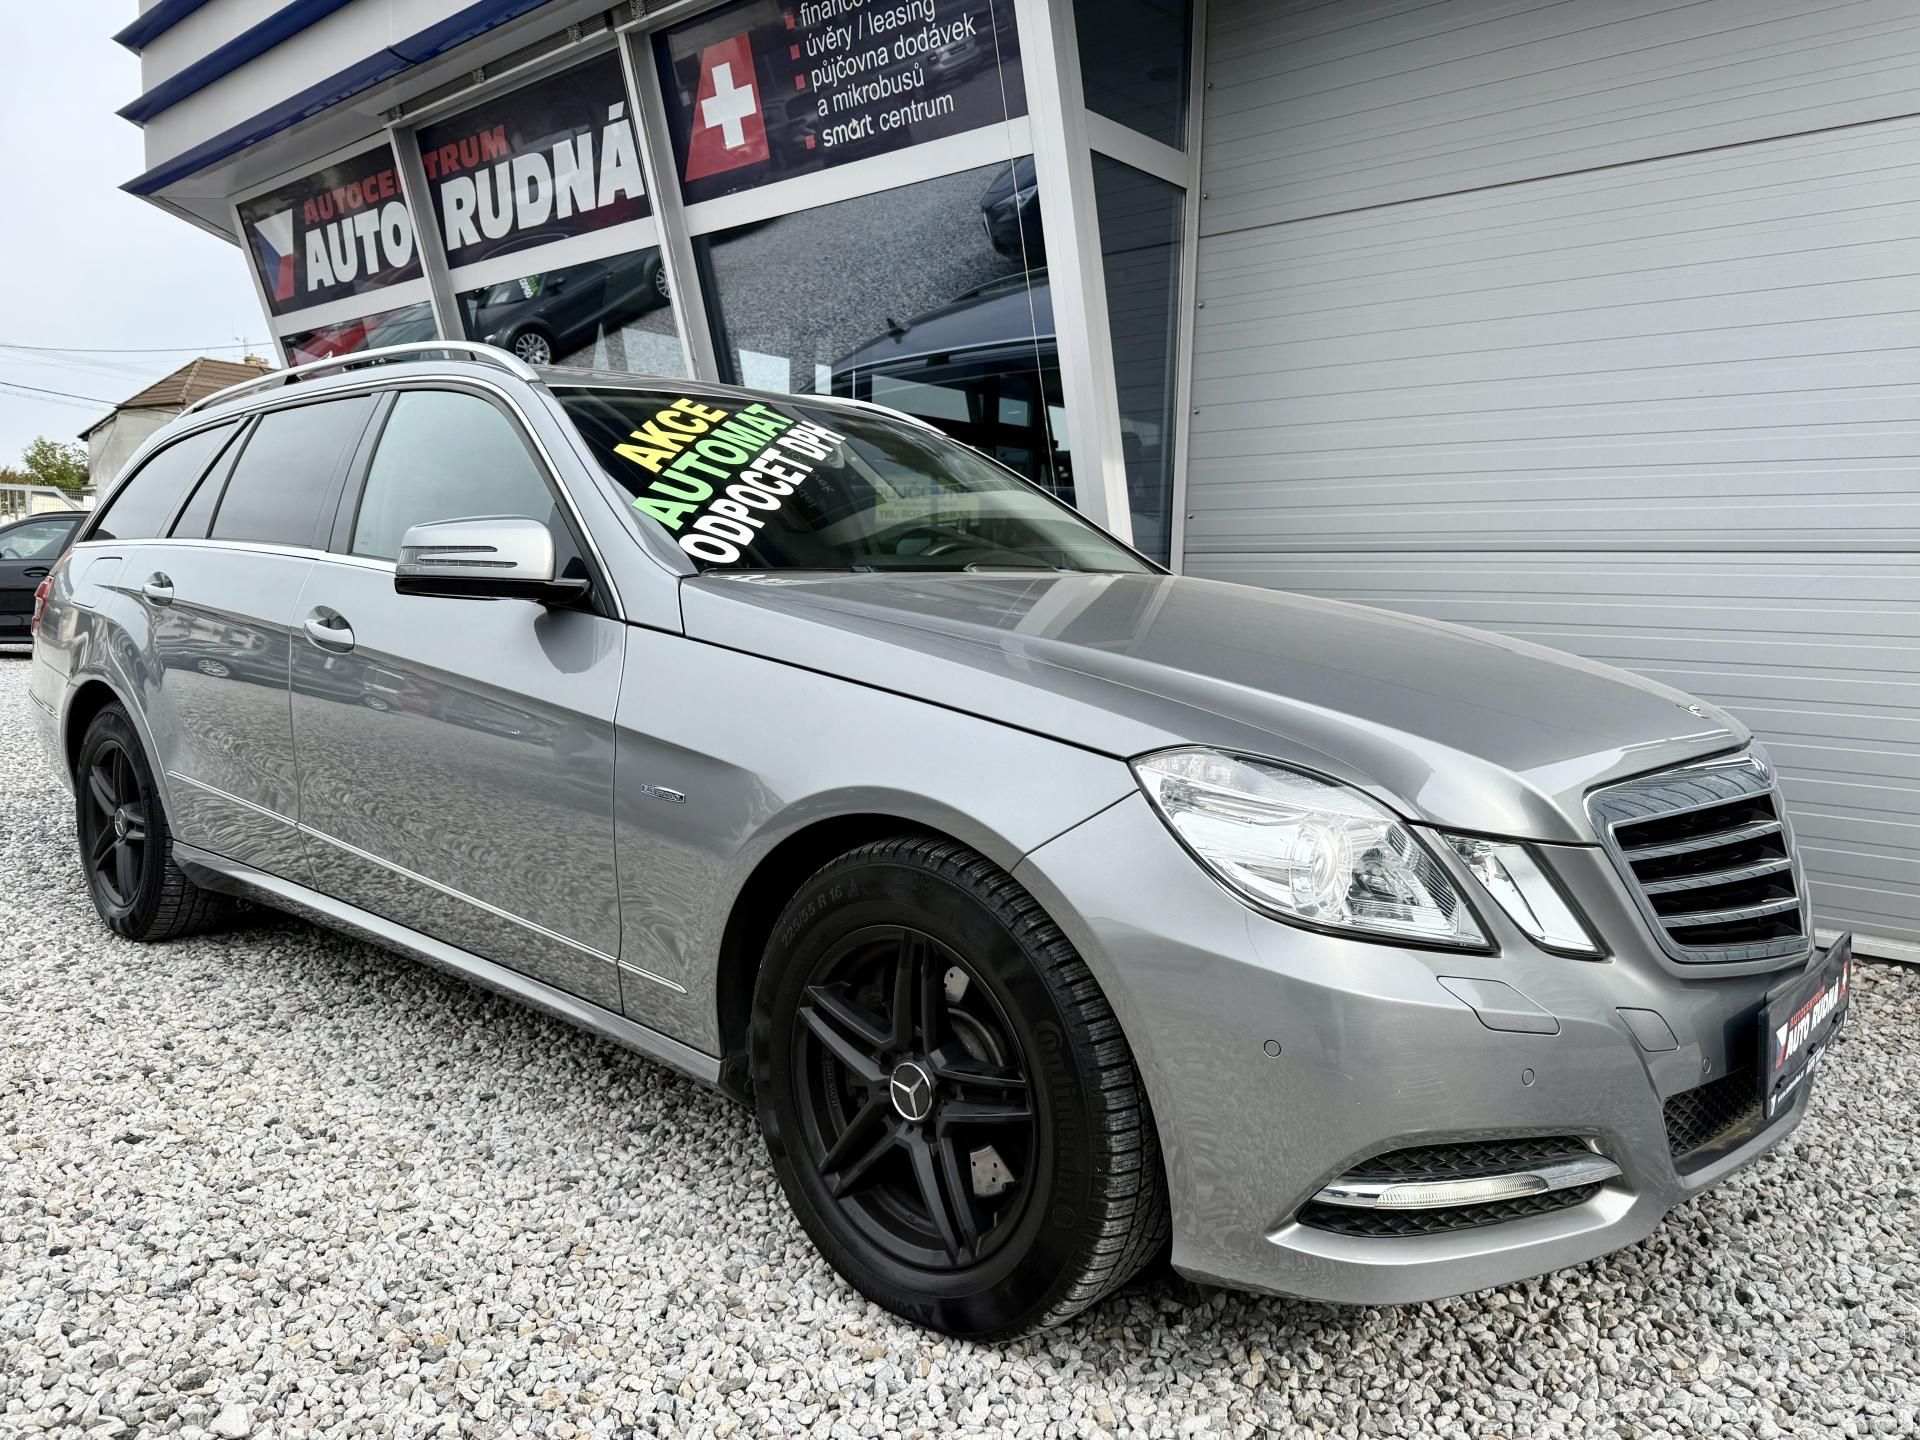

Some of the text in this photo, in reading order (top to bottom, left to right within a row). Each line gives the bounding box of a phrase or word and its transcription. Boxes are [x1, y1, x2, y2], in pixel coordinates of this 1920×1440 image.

[800, 0, 871, 27] financ
[806, 0, 936, 57] úvěry / leasing
[811, 12, 977, 92] půjčovna dodávek
[816, 64, 925, 117] a mikrobusů
[821, 93, 955, 149] smart centrum
[305, 102, 646, 292] AUTO RUDNÁ
[613, 398, 729, 473] AKCE
[632, 403, 795, 531] AUTOMAT
[678, 447, 814, 564] ODPOCET
[775, 420, 847, 461] DPH
[1785, 1013, 1810, 1060] AUTO
[1811, 976, 1839, 1031] RUDNÁ
[1032, 1019, 1082, 1204] Continental
